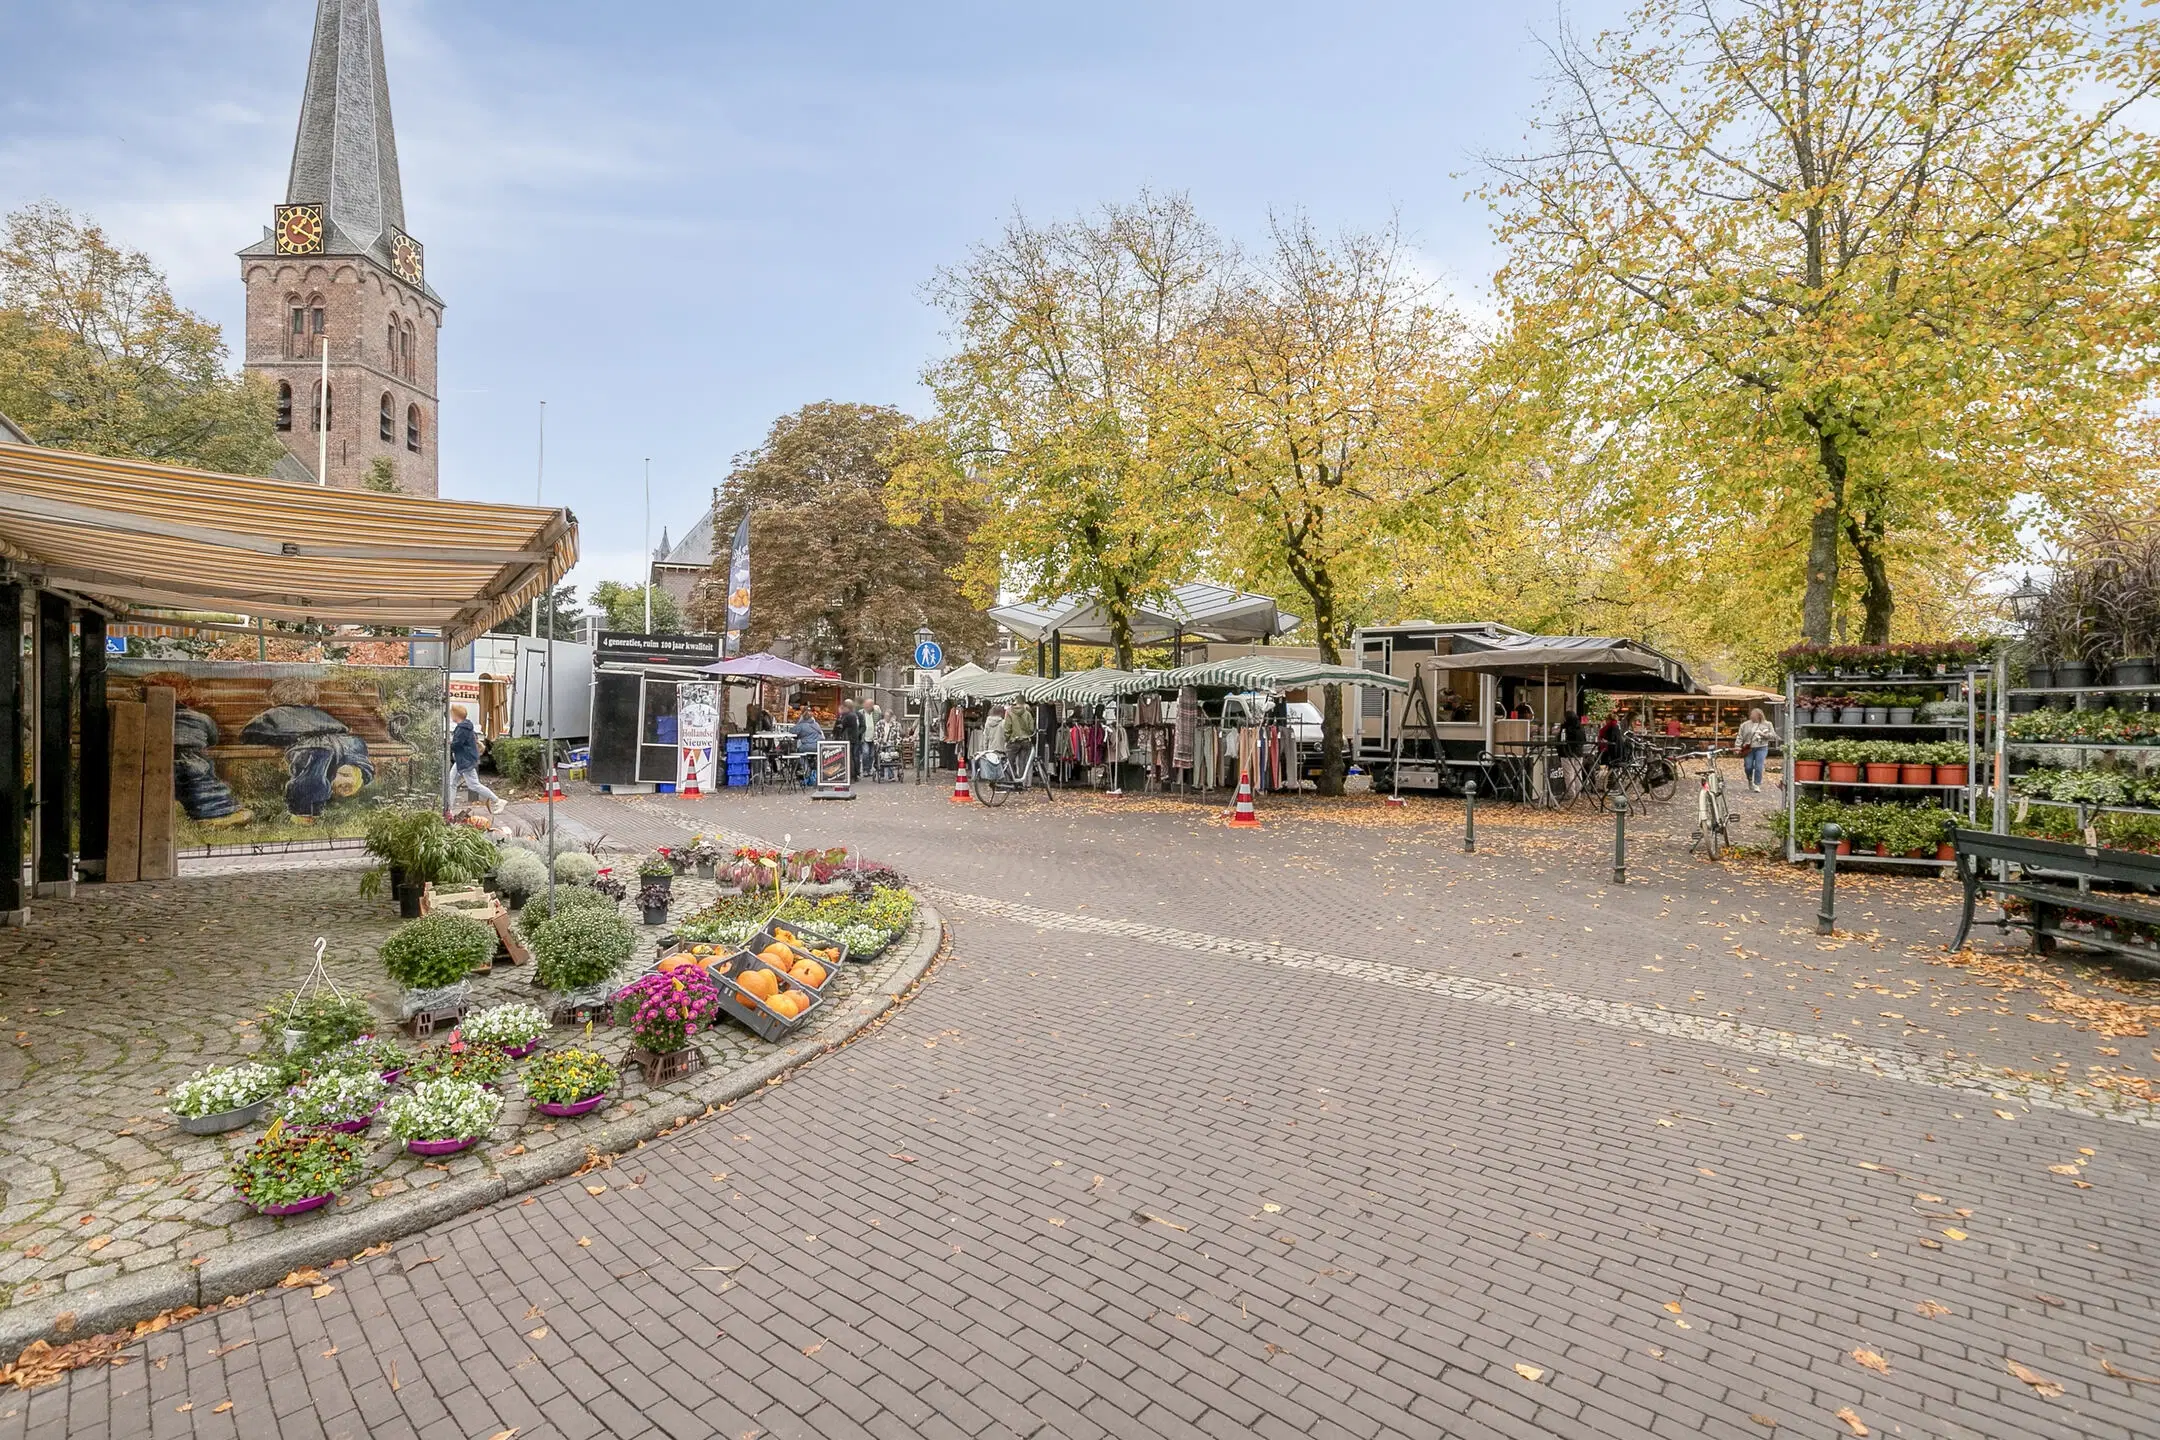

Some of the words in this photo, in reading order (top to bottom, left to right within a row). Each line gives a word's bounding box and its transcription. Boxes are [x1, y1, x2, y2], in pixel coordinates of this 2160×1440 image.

[603, 637, 608, 646] 4
[608, 638, 642, 648] generaties,
[643, 640, 659, 648] ruim
[661, 641, 671, 649] 100
[672, 641, 685, 650] jaar
[685, 643, 714, 651] kwaliteit
[683, 738, 712, 746] Nieuwe
